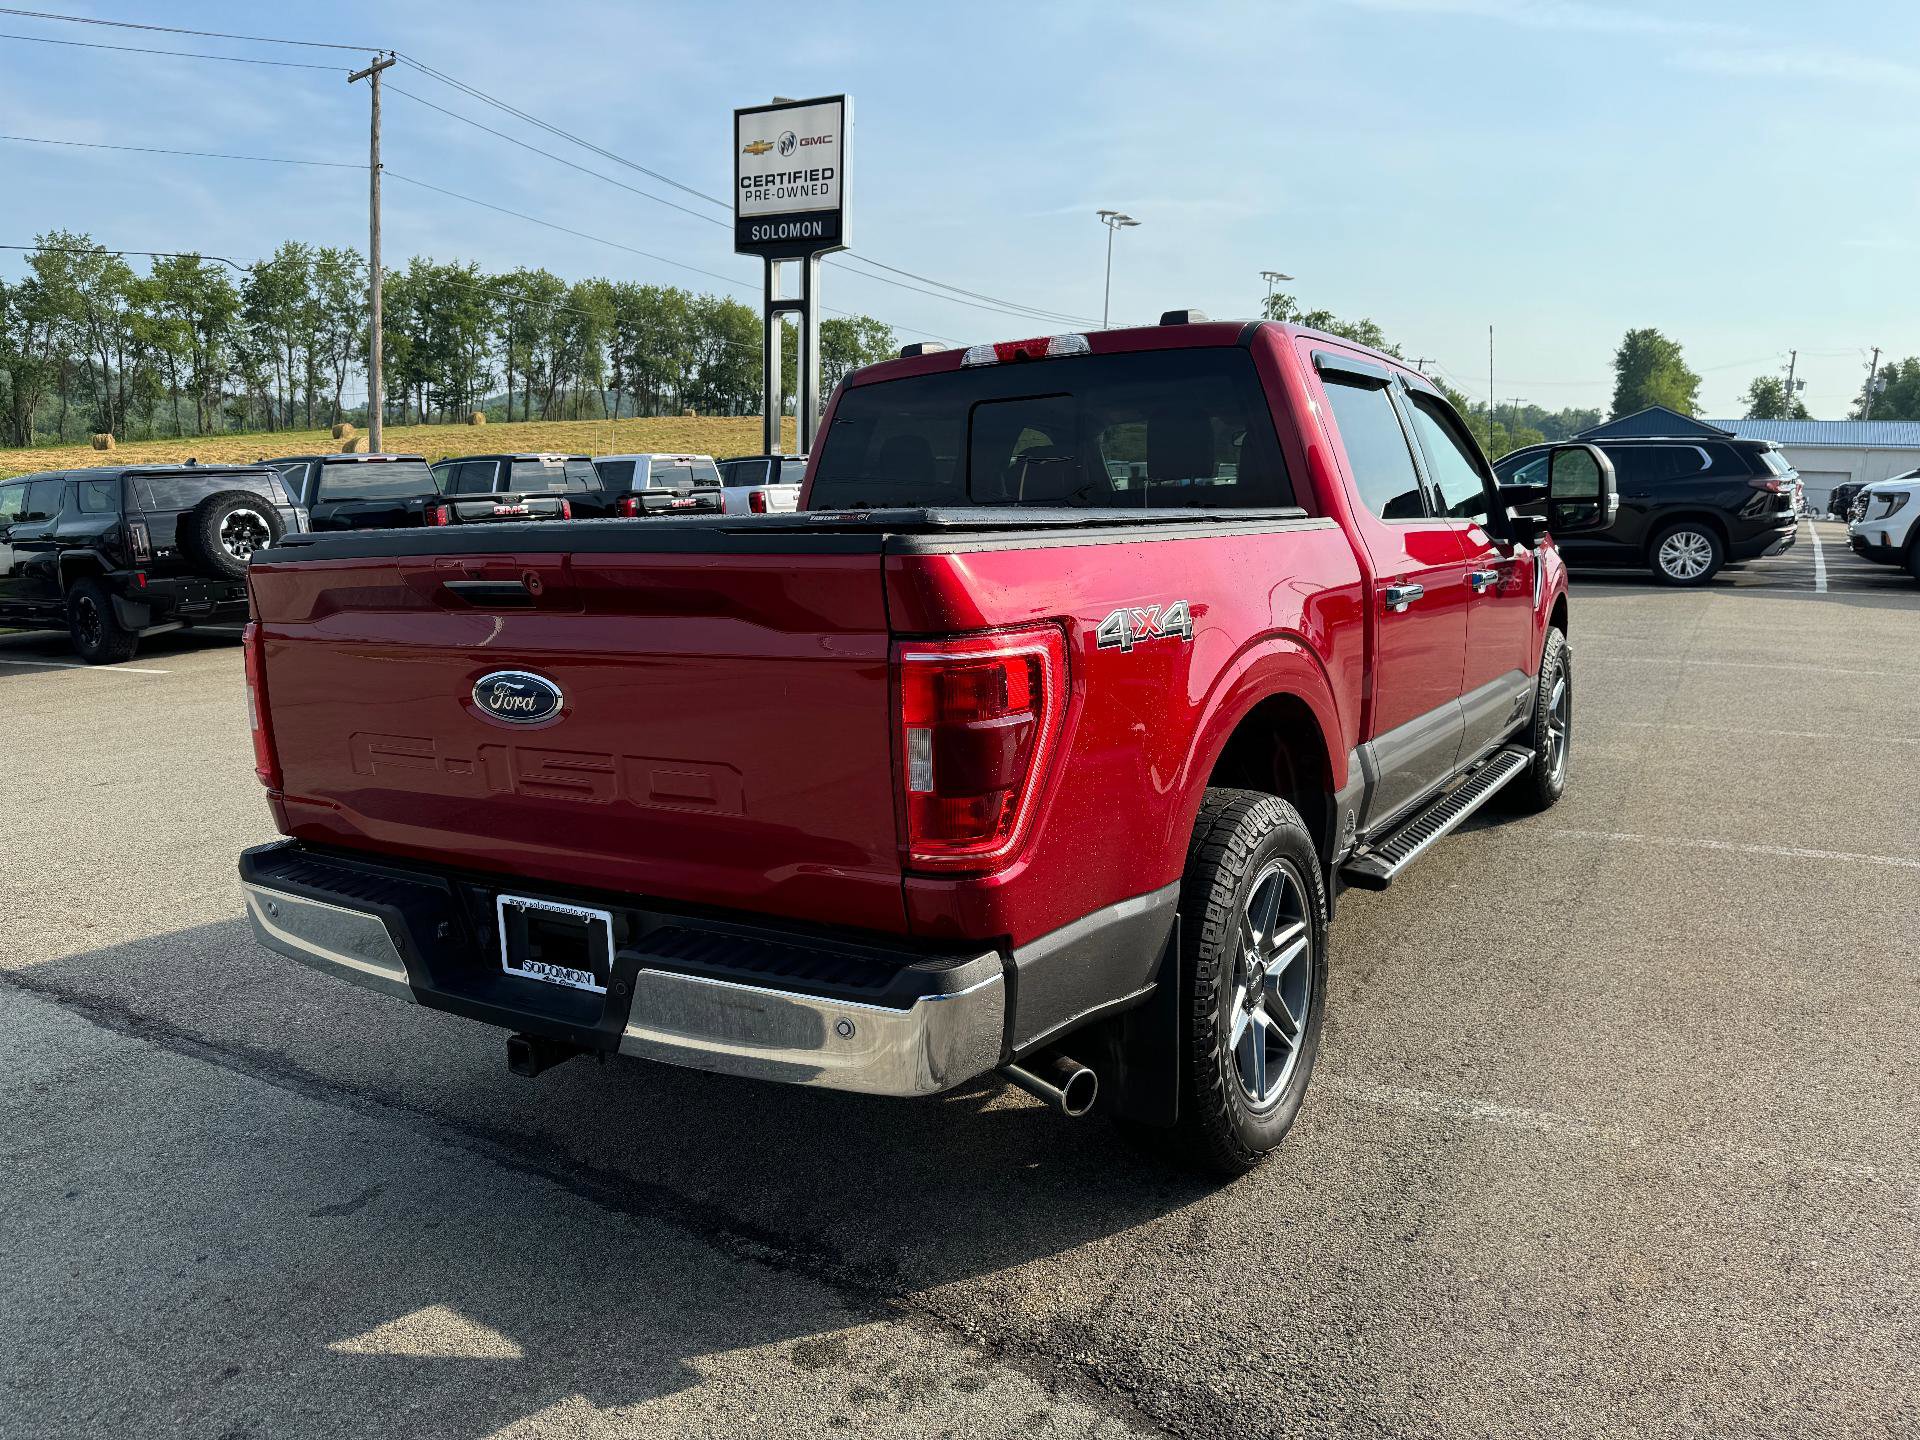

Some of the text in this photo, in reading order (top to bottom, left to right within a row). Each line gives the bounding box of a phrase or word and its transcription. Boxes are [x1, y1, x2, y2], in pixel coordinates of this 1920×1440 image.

[800, 135, 833, 147] GMC
[740, 167, 835, 189] CERTIFIED
[745, 183, 829, 202] PRE-OWNED
[752, 221, 823, 241] SOLOMON
[490, 681, 537, 712] Ford
[348, 731, 747, 817] F-150
[523, 960, 592, 986] SOLOMON
